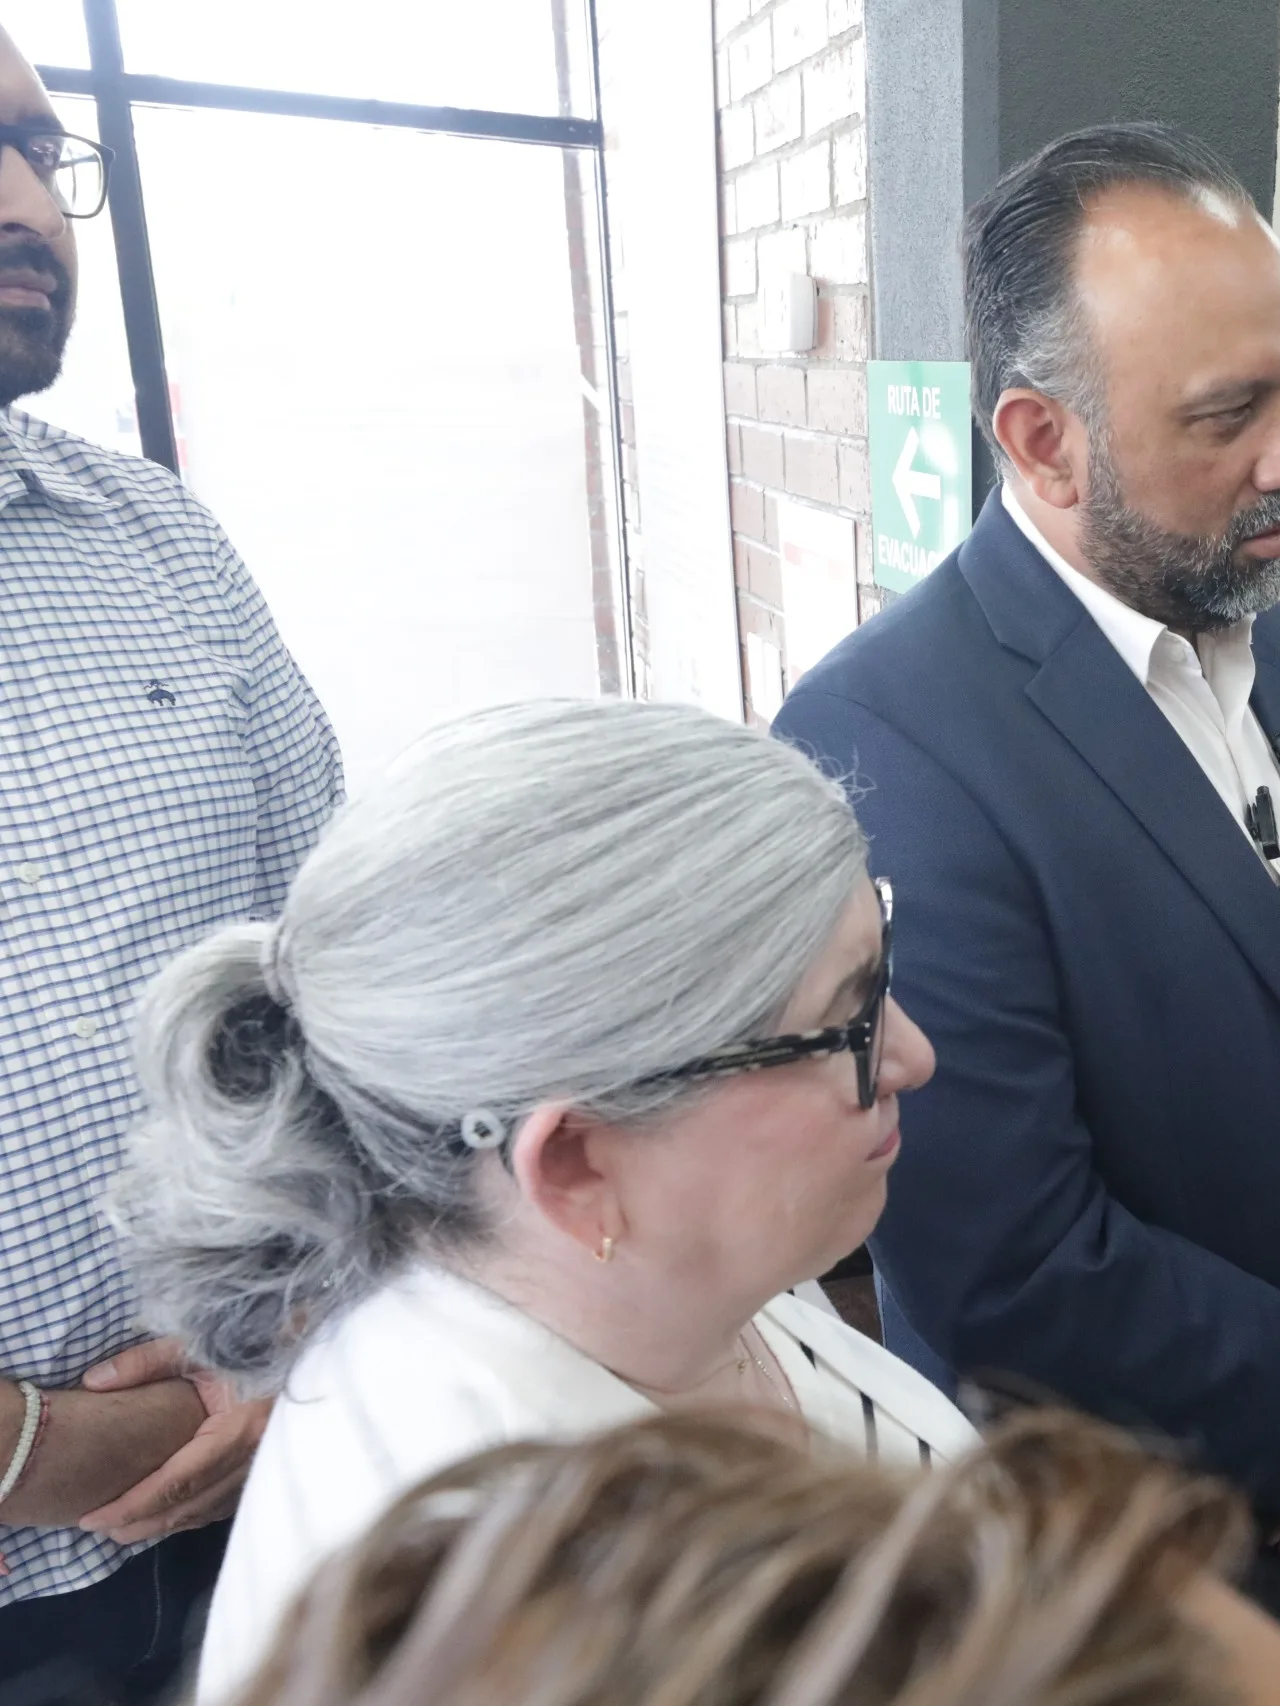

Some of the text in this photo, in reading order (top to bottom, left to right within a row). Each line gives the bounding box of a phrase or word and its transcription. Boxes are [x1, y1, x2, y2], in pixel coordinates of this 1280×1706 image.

[887, 385, 941, 419] RUTA DE
[878, 534, 945, 578] EVACUAC
